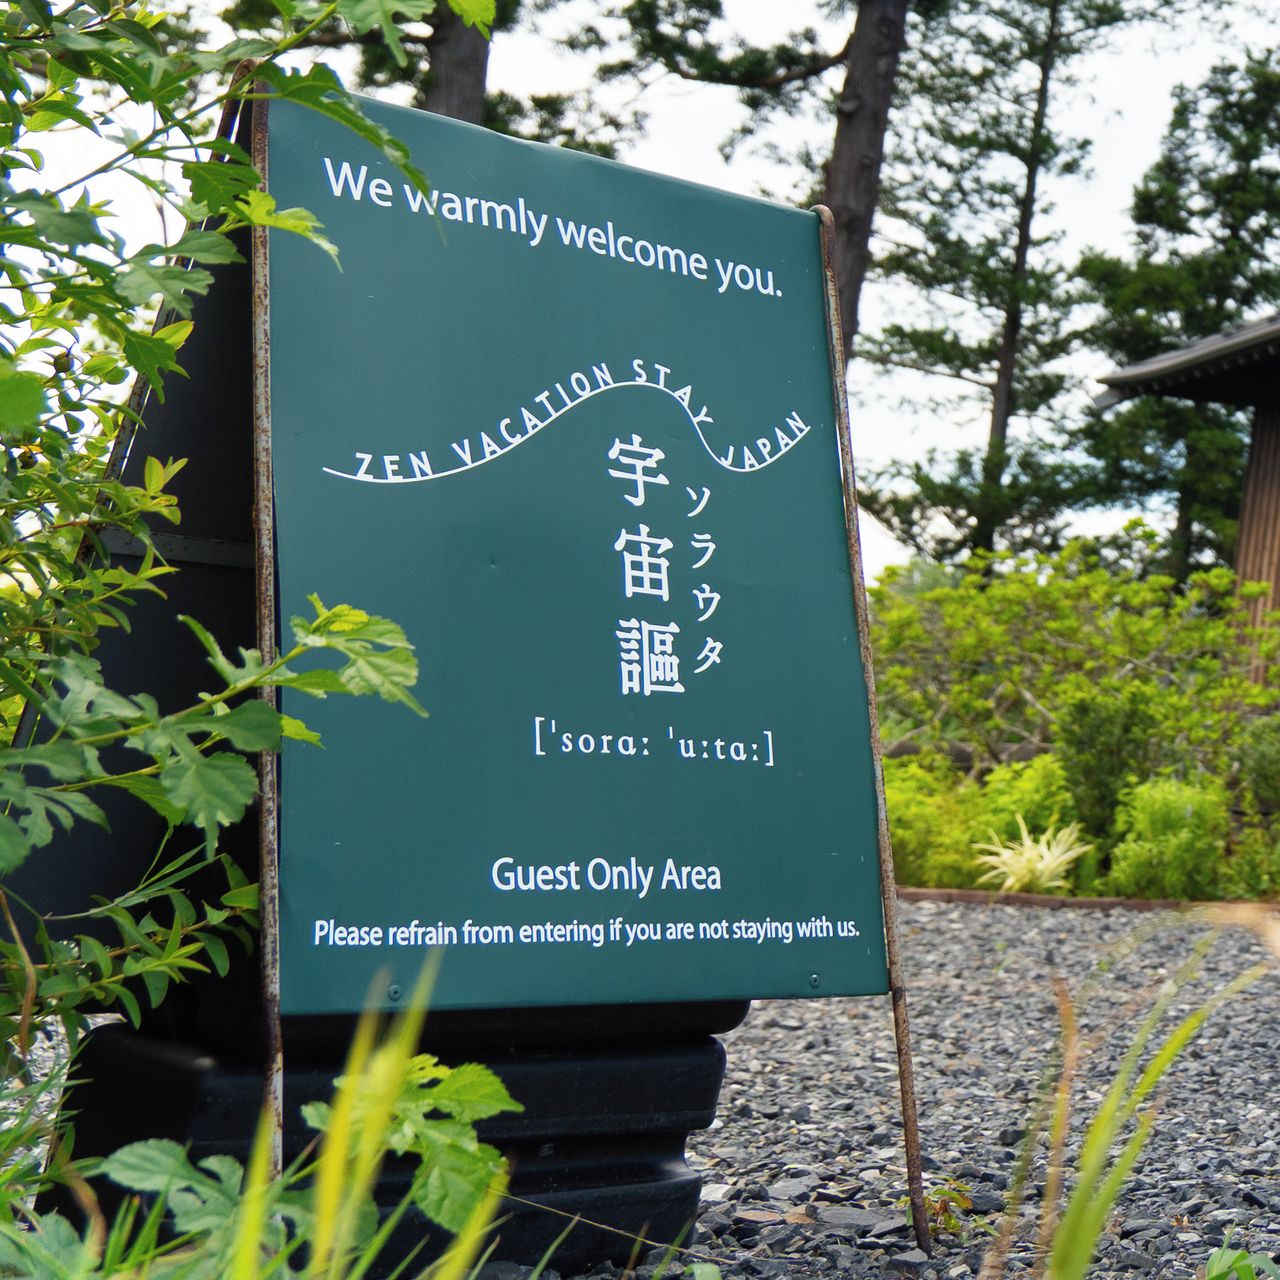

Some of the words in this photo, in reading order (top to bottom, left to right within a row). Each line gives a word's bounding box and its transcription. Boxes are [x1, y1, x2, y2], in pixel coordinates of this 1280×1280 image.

[323, 157, 394, 207] We
[403, 183, 549, 247] warmly
[556, 217, 708, 280] welcome
[714, 258, 784, 297] you.
[355, 452, 432, 480] ZEN
[451, 361, 615, 467] VACATION
[631, 358, 714, 425] STAY
[720, 410, 809, 470] JAPAN
[607, 433, 686, 697] 宇宙謳
[686, 486, 724, 674] ソラウタ
[315, 920, 383, 946] Please
[388, 919, 458, 946] refrain
[462, 919, 514, 945] from
[519, 917, 605, 948] entering
[609, 917, 623, 941] if
[624, 923, 662, 947] you
[666, 922, 695, 941] are
[699, 919, 730, 940] not
[732, 918, 793, 945] staying
[796, 916, 834, 939] with
[837, 920, 861, 938] us.
[492, 857, 581, 891] Guest
[587, 857, 654, 899] Only
[660, 858, 723, 891] Area
